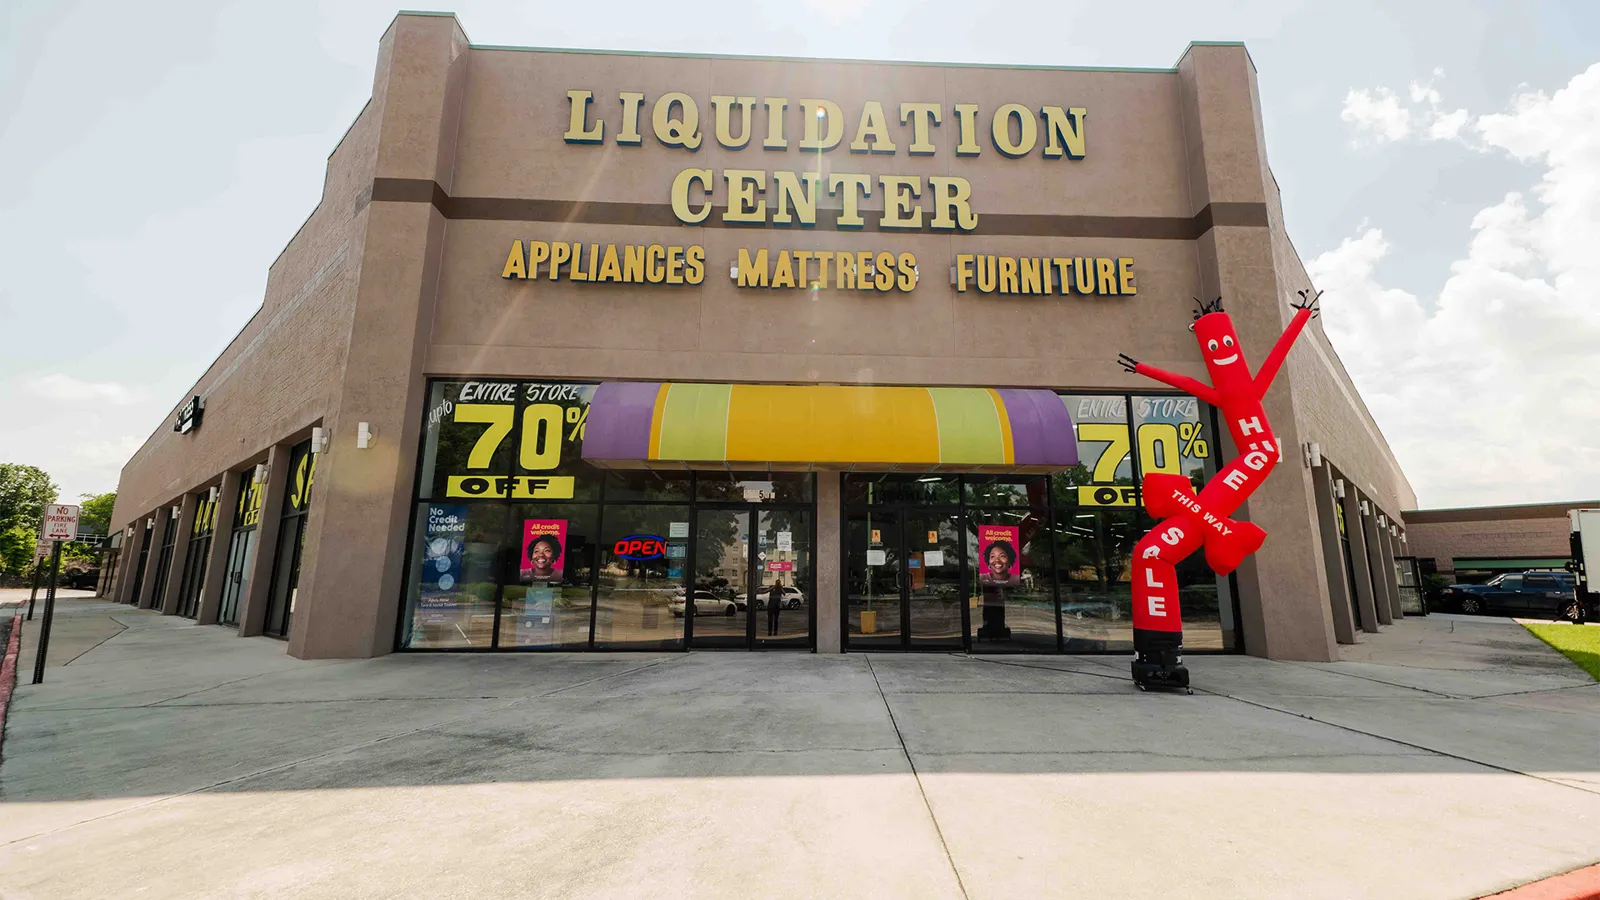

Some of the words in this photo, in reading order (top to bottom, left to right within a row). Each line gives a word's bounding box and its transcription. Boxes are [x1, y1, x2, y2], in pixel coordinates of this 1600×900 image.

[564, 89, 1087, 159] LIQUIDATION
[671, 168, 978, 231] CENTER
[501, 238, 705, 284] APPLIANCES
[737, 248, 918, 292] MATTRESS
[956, 253, 1137, 296] FURNITURE
[459, 381, 518, 402] ENTIRE
[526, 384, 582, 401] STORE
[1077, 398, 1126, 419] ENTIRE
[1137, 398, 1198, 419] STORE
[459, 477, 550, 495] OFF
[1093, 487, 1143, 504] OF
[48, 515, 76, 523] PARKING
[428, 515, 458, 524] Credit
[429, 507, 444, 516] No
[1171, 489, 1201, 514] THIS
[1202, 512, 1233, 536] WAY
[428, 523, 465, 532] Needed
[613, 540, 668, 555] OPEN
[1142, 526, 1184, 617] SALE
